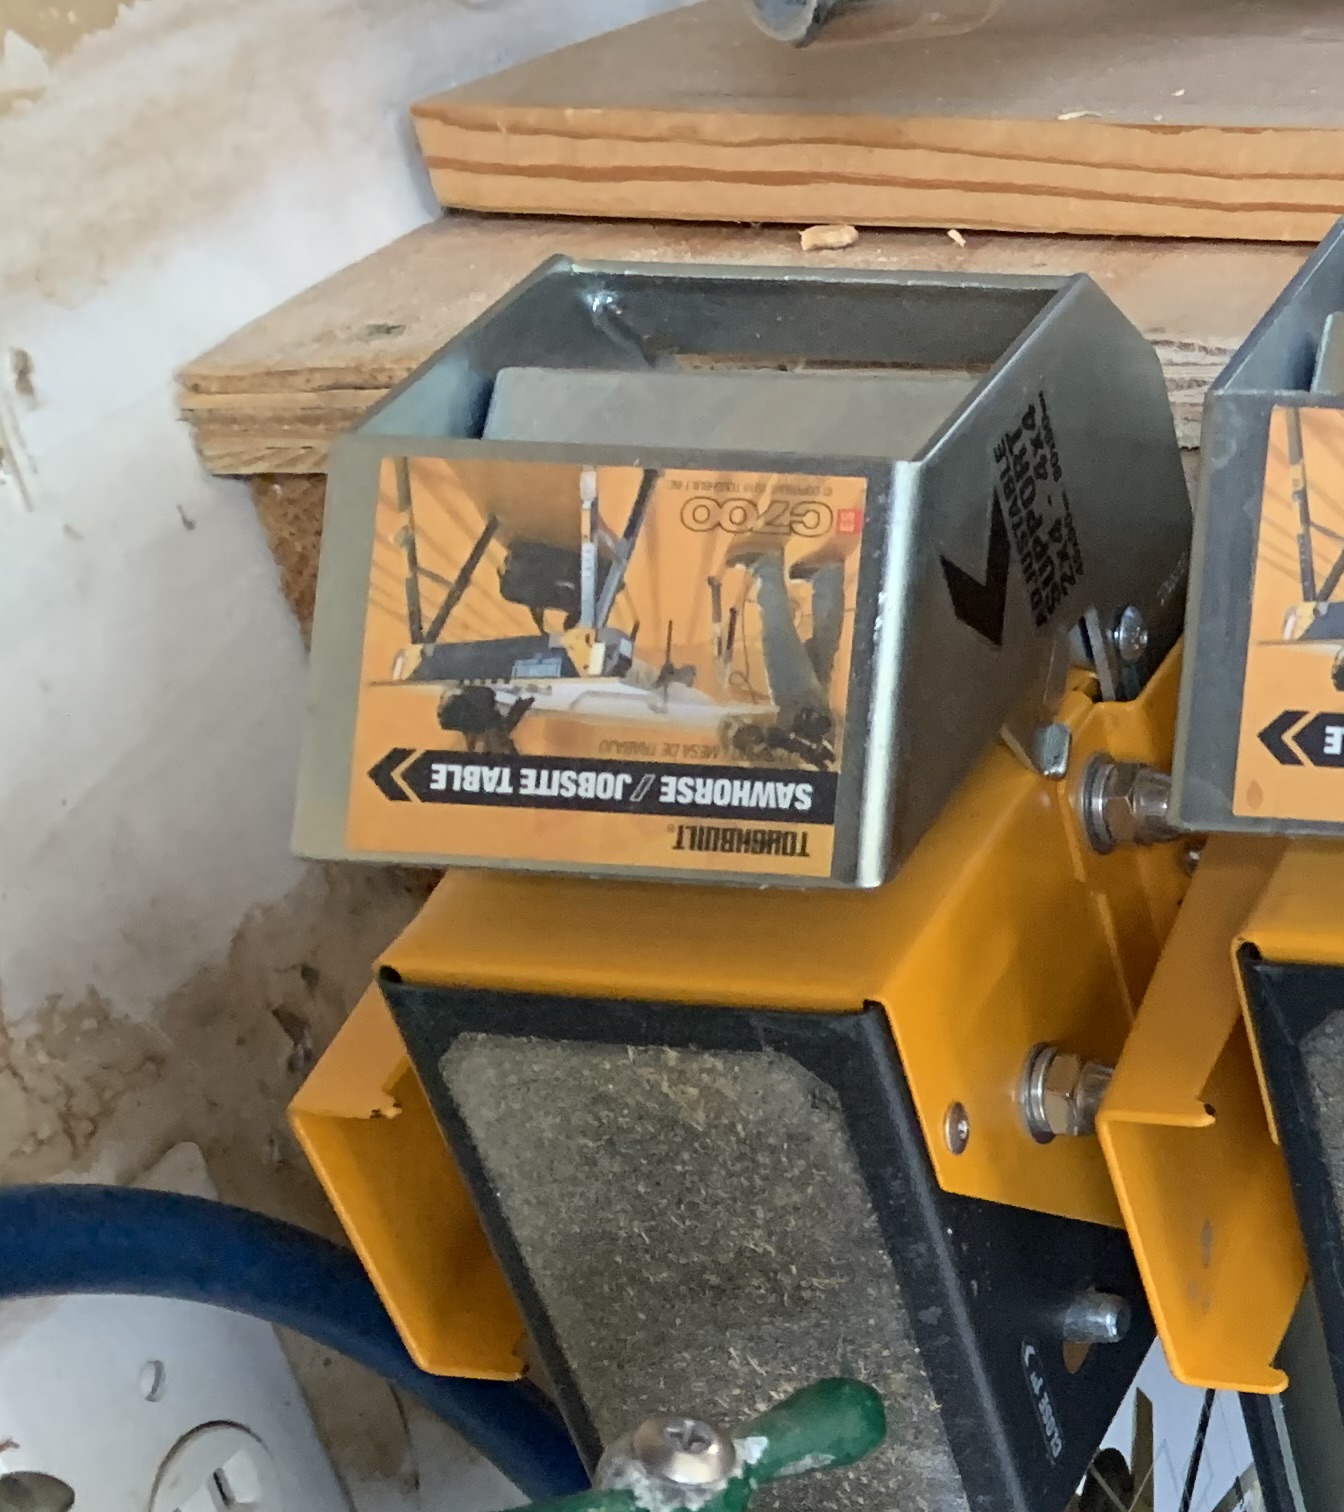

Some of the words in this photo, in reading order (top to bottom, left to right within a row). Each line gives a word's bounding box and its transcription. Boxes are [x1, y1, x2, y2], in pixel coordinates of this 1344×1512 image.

[680, 497, 833, 538] C700
[1006, 431, 1062, 614] SUPPORT
[430, 763, 513, 794] TABLE
[520, 768, 633, 800] JOBSITE
[659, 776, 813, 810] SAWHORSE
[672, 825, 810, 857] TOUGHBUILT
